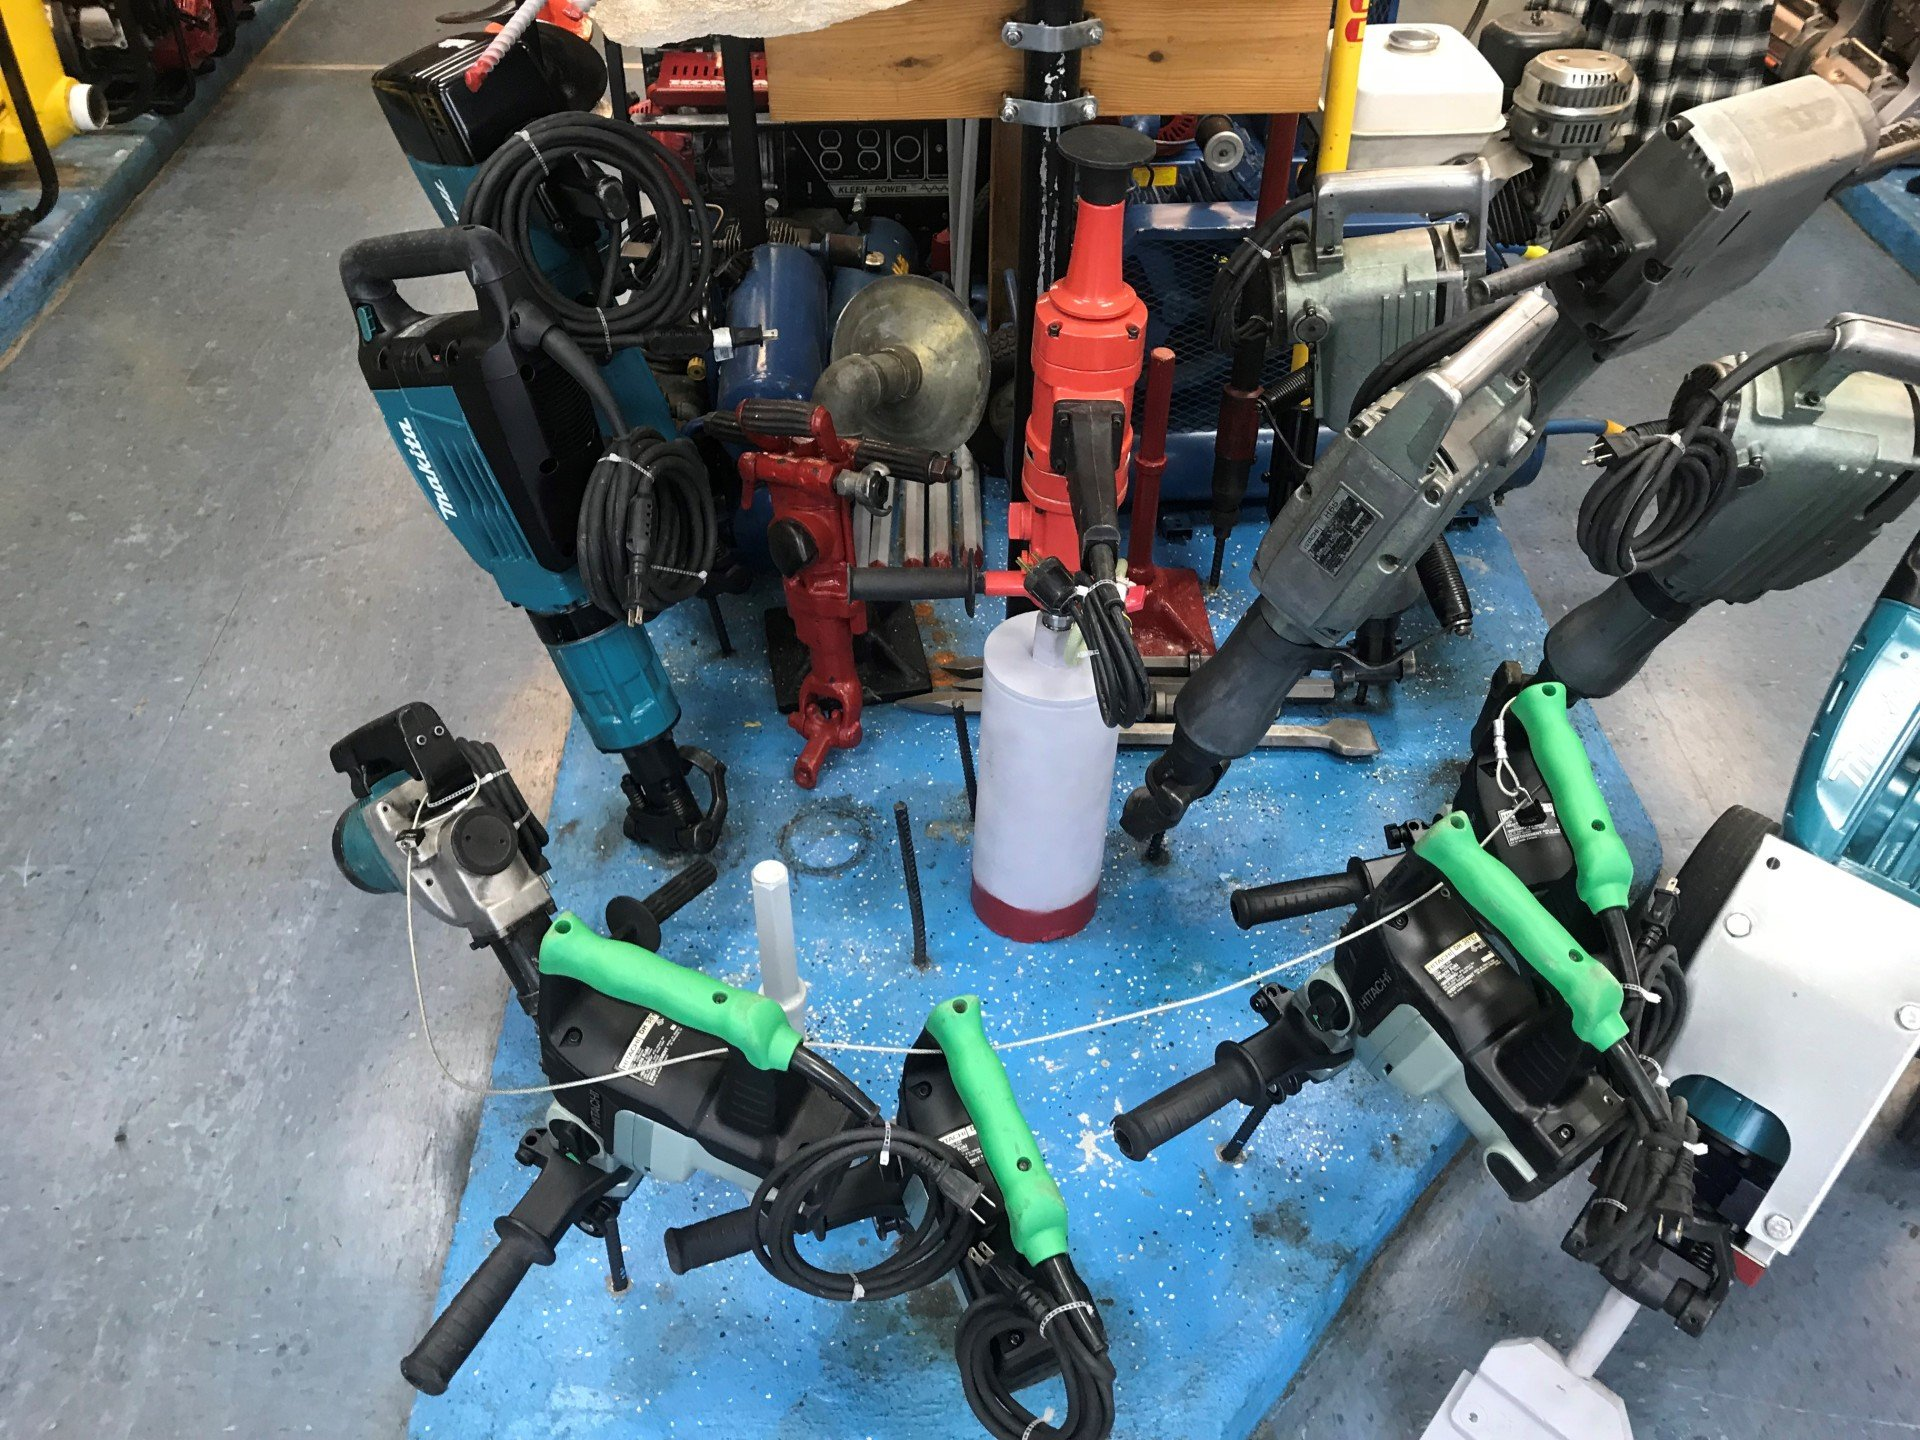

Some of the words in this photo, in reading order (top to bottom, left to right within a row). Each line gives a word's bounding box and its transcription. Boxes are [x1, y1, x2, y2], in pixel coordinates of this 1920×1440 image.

[838, 185, 867, 194] KLEEN
[874, 185, 907, 193] POWER
[1427, 951, 1454, 970] HITACHI
[1359, 971, 1392, 1009] HITACHI
[622, 1037, 641, 1068] HITACHI
[639, 1025, 648, 1035] DH
